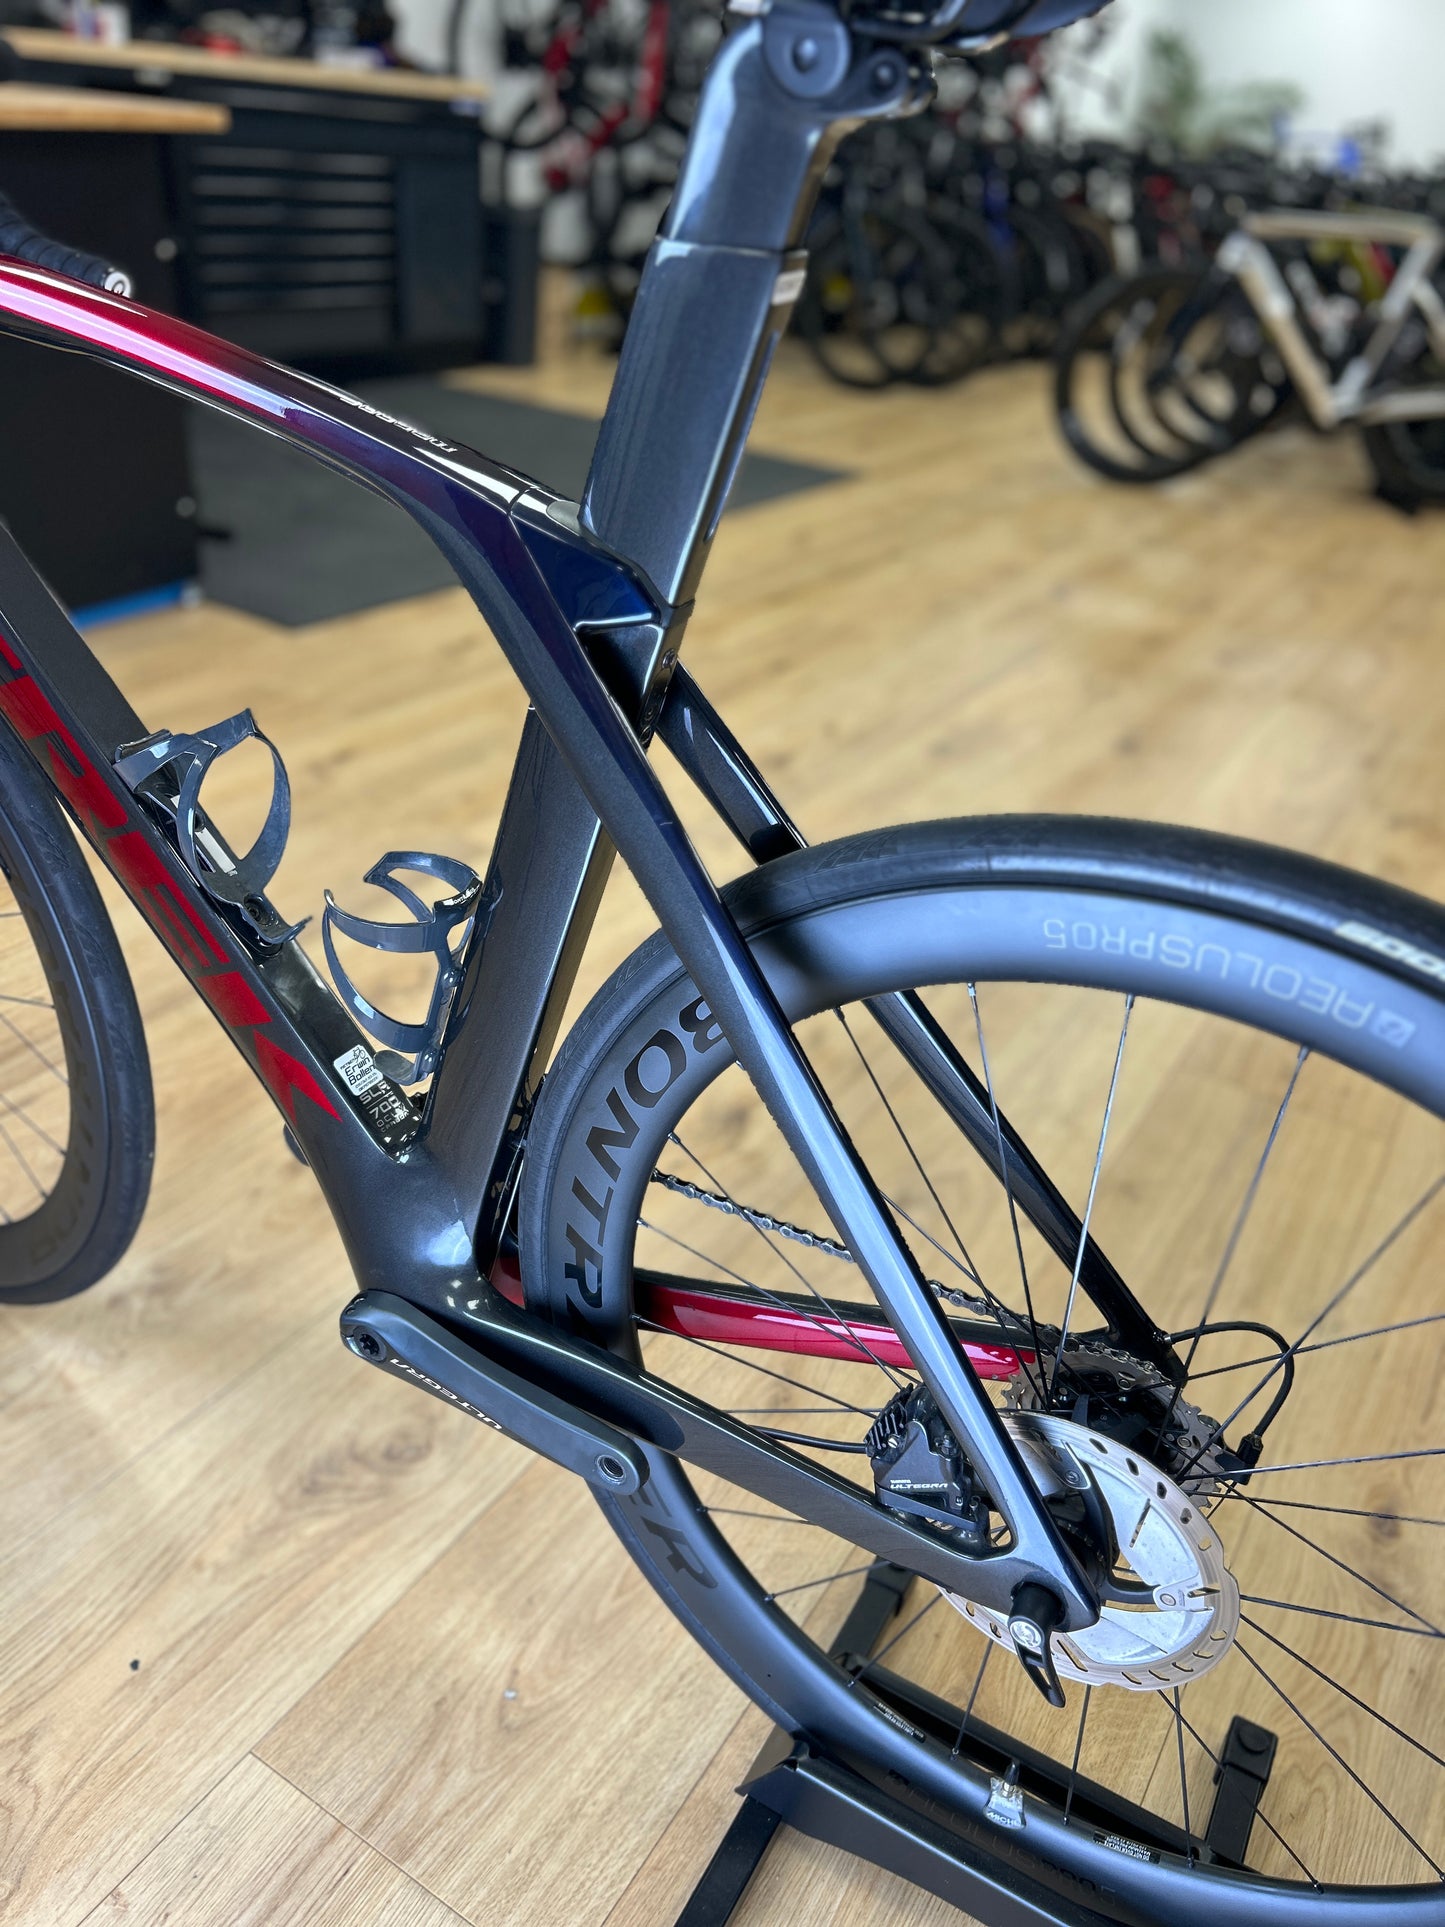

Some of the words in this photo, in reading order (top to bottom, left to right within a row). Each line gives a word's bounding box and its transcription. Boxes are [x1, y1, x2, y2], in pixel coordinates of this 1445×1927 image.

[344, 1057, 371, 1077] Erwin
[347, 1064, 376, 1085] Bollen
[389, 1358, 502, 1430] ULTEGRA
[889, 1482, 949, 1490] ULTEGRA
